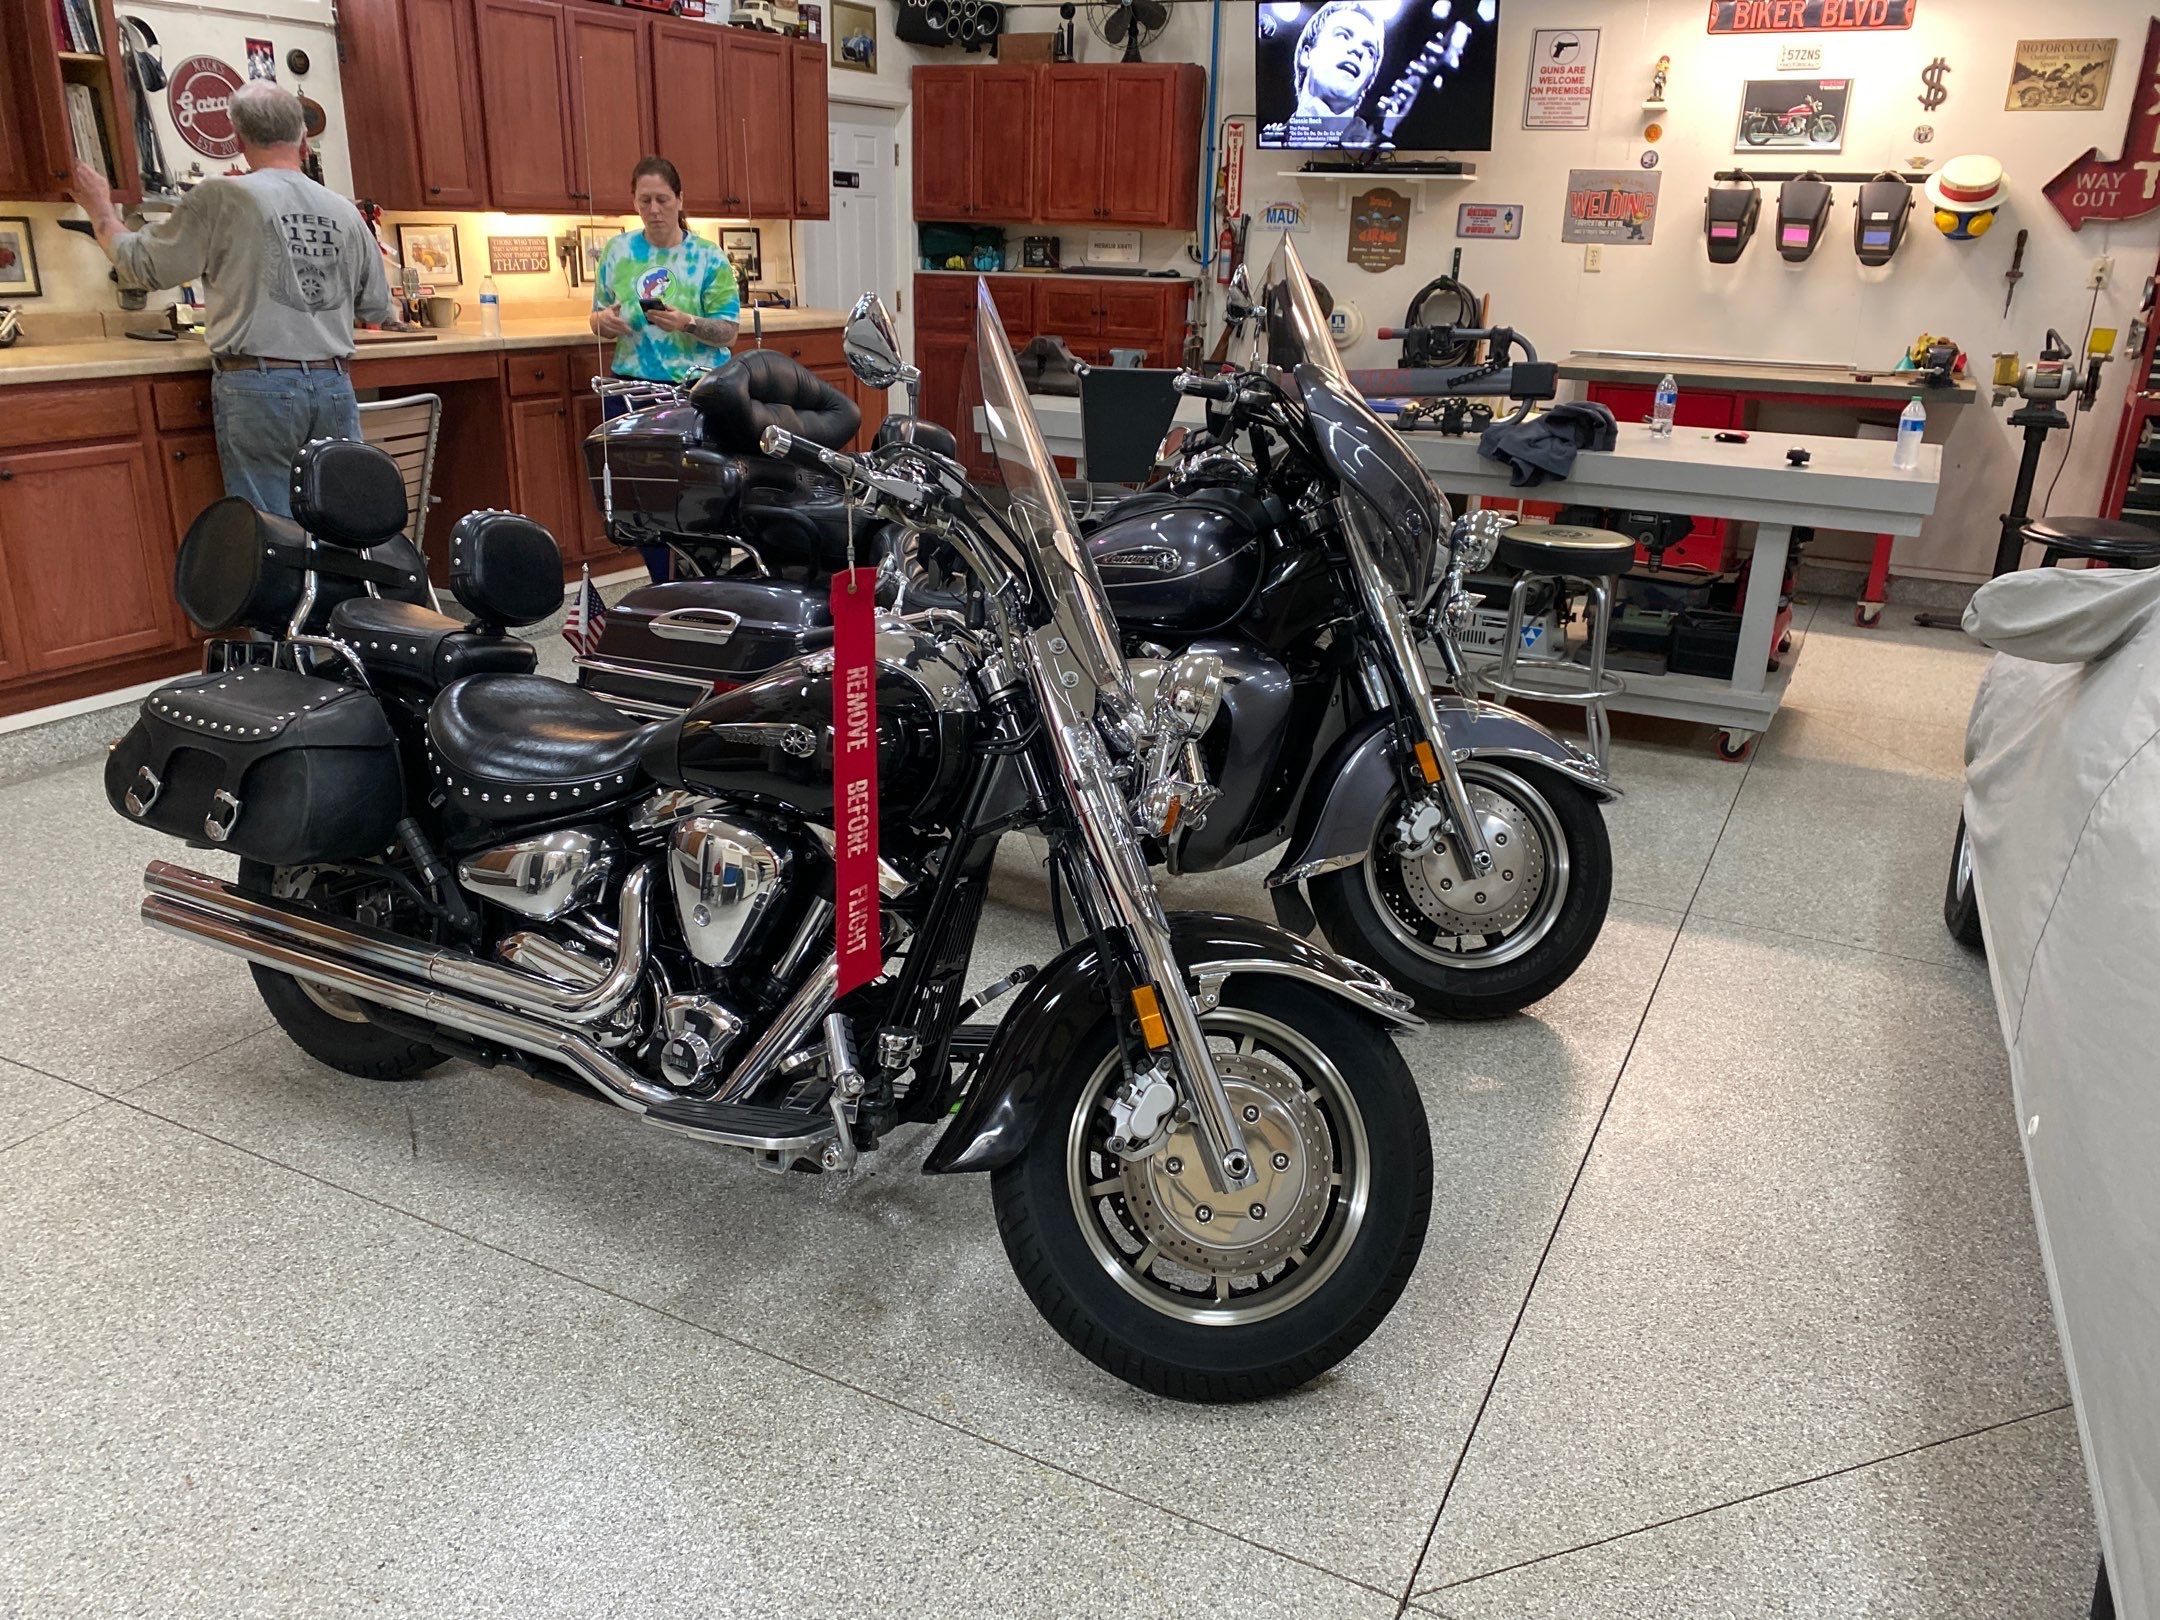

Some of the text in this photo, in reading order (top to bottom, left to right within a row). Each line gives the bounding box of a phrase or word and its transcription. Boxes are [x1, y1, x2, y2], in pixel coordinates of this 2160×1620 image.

[1733, 0, 1889, 29] BIKER BLVD
[2021, 43, 2111, 53] MOTORCYCLING
[1540, 66, 1586, 75] GUNS ARE
[1539, 77, 1586, 85] WELCOME
[1530, 86, 1592, 95] ON PREMISES
[221, 138, 240, 155] 201
[1229, 138, 1239, 211] EXTINGUISHER
[2076, 172, 2126, 190] WAY
[1570, 189, 1655, 220] WELDING
[2072, 191, 2120, 207] OUT
[281, 213, 342, 233] STEEL
[1266, 207, 1299, 224] MAUI
[290, 226, 334, 245] 131
[493, 257, 548, 271] THAT DO
[1103, 553, 1154, 564] Venture
[846, 665, 869, 753] REMOVE
[847, 778, 869, 859] BEFORE
[846, 883, 869, 955] FLIGHT
